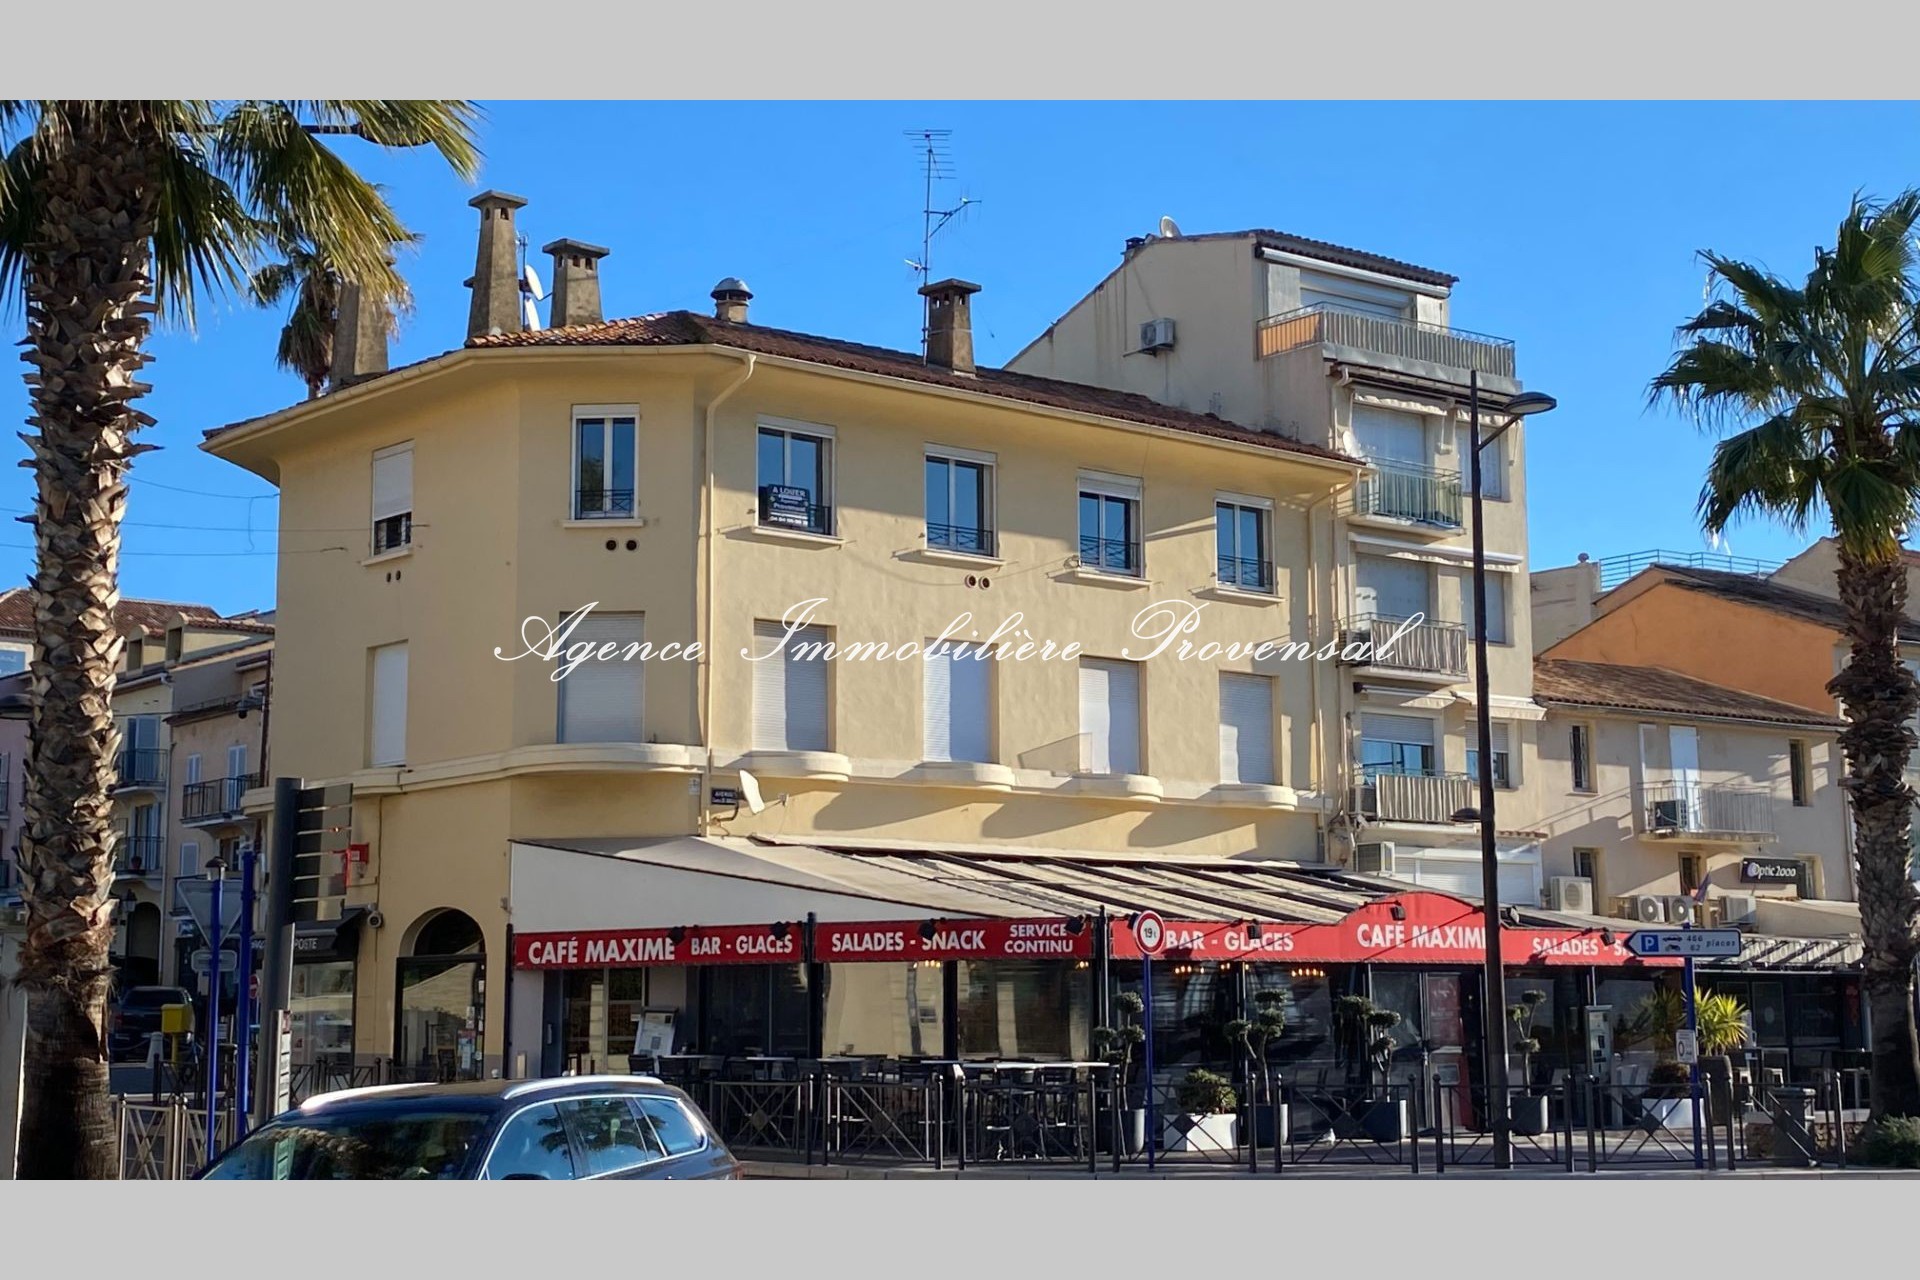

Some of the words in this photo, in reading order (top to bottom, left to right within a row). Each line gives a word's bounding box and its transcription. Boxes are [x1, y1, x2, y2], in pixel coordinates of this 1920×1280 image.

[831, 932, 904, 952] SALADES
[921, 930, 986, 951] SNACK
[1009, 923, 1068, 938] SERVICE
[1164, 930, 1205, 950] BAR
[1224, 930, 1294, 952] GLACES
[1356, 920, 1405, 949] CAFÉ
[528, 936, 578, 964] CAFÉ
[584, 937, 675, 963] MAXIME
[690, 935, 721, 956] BAR
[735, 934, 793, 955] GLACES
[1004, 938, 1073, 954] CONTINU
[1532, 937, 1599, 956] SALADES
